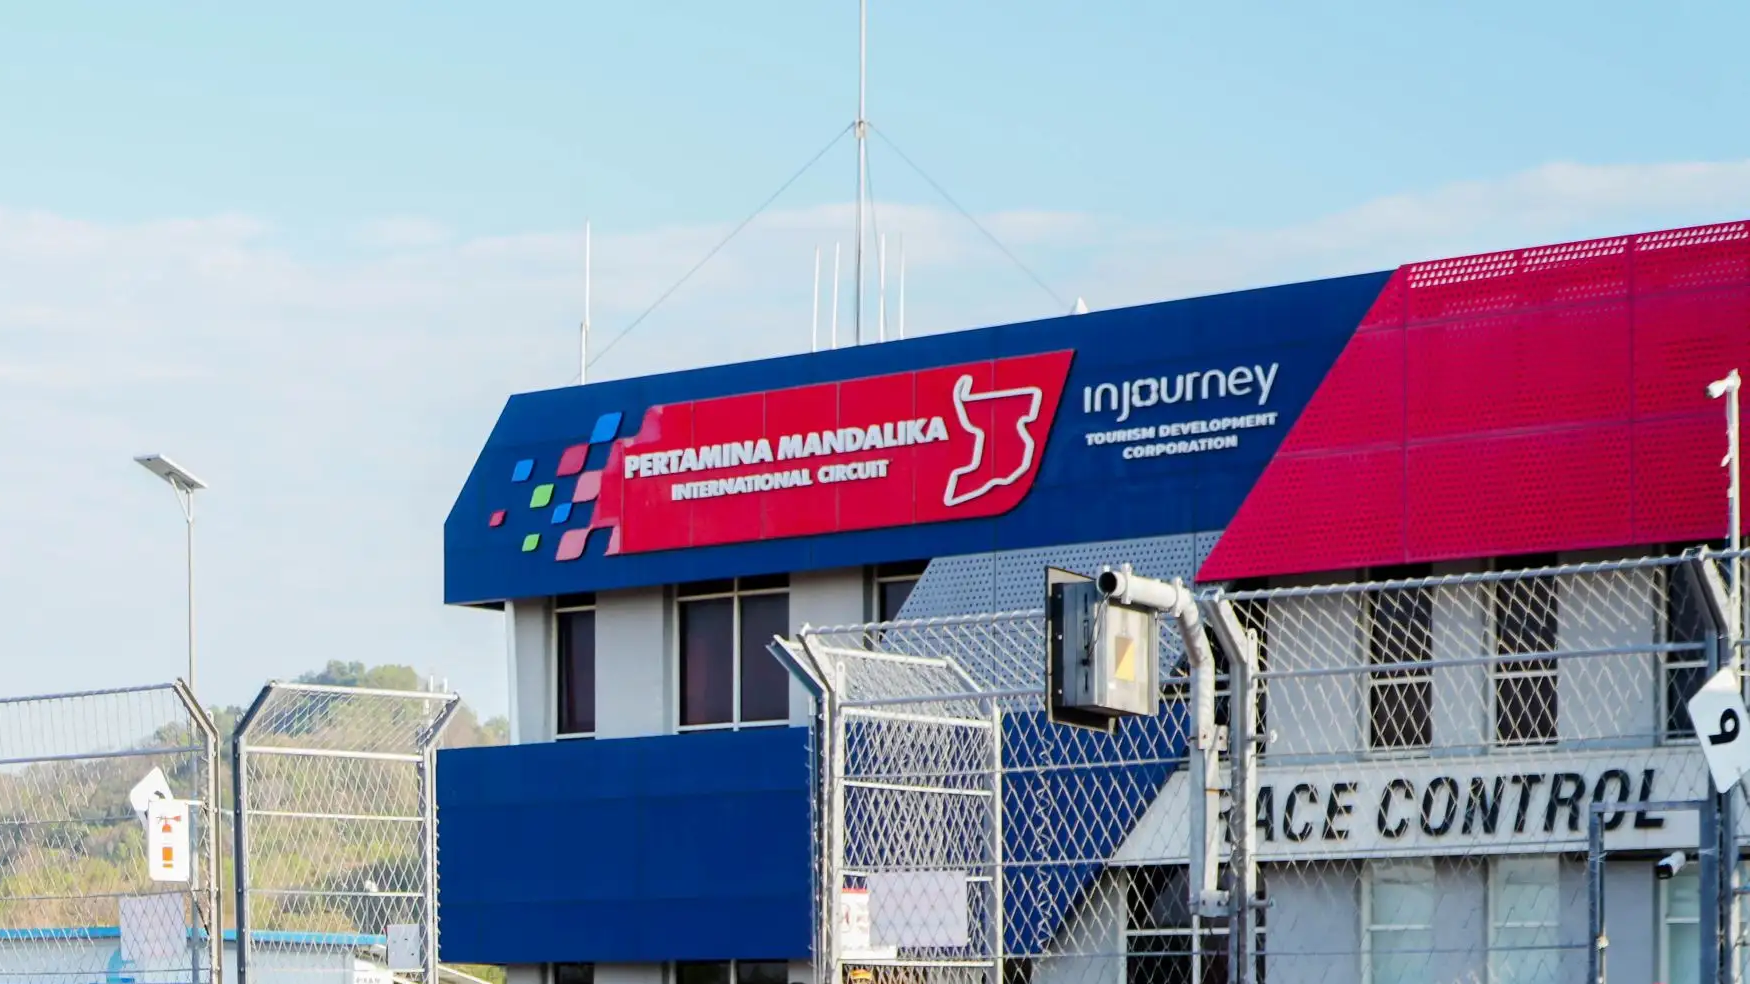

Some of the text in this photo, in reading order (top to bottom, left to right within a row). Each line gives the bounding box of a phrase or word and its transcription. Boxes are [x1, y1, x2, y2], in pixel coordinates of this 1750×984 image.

[624, 416, 949, 480] PERTAMINA MANDALIKA
[1085, 412, 1279, 446] TOURISM DEVELOPMENT
[1122, 435, 1239, 460] CORPORATION
[670, 459, 891, 501] INTERNATIONAL CIRCUIT
[1376, 767, 1666, 841] CONTROL
